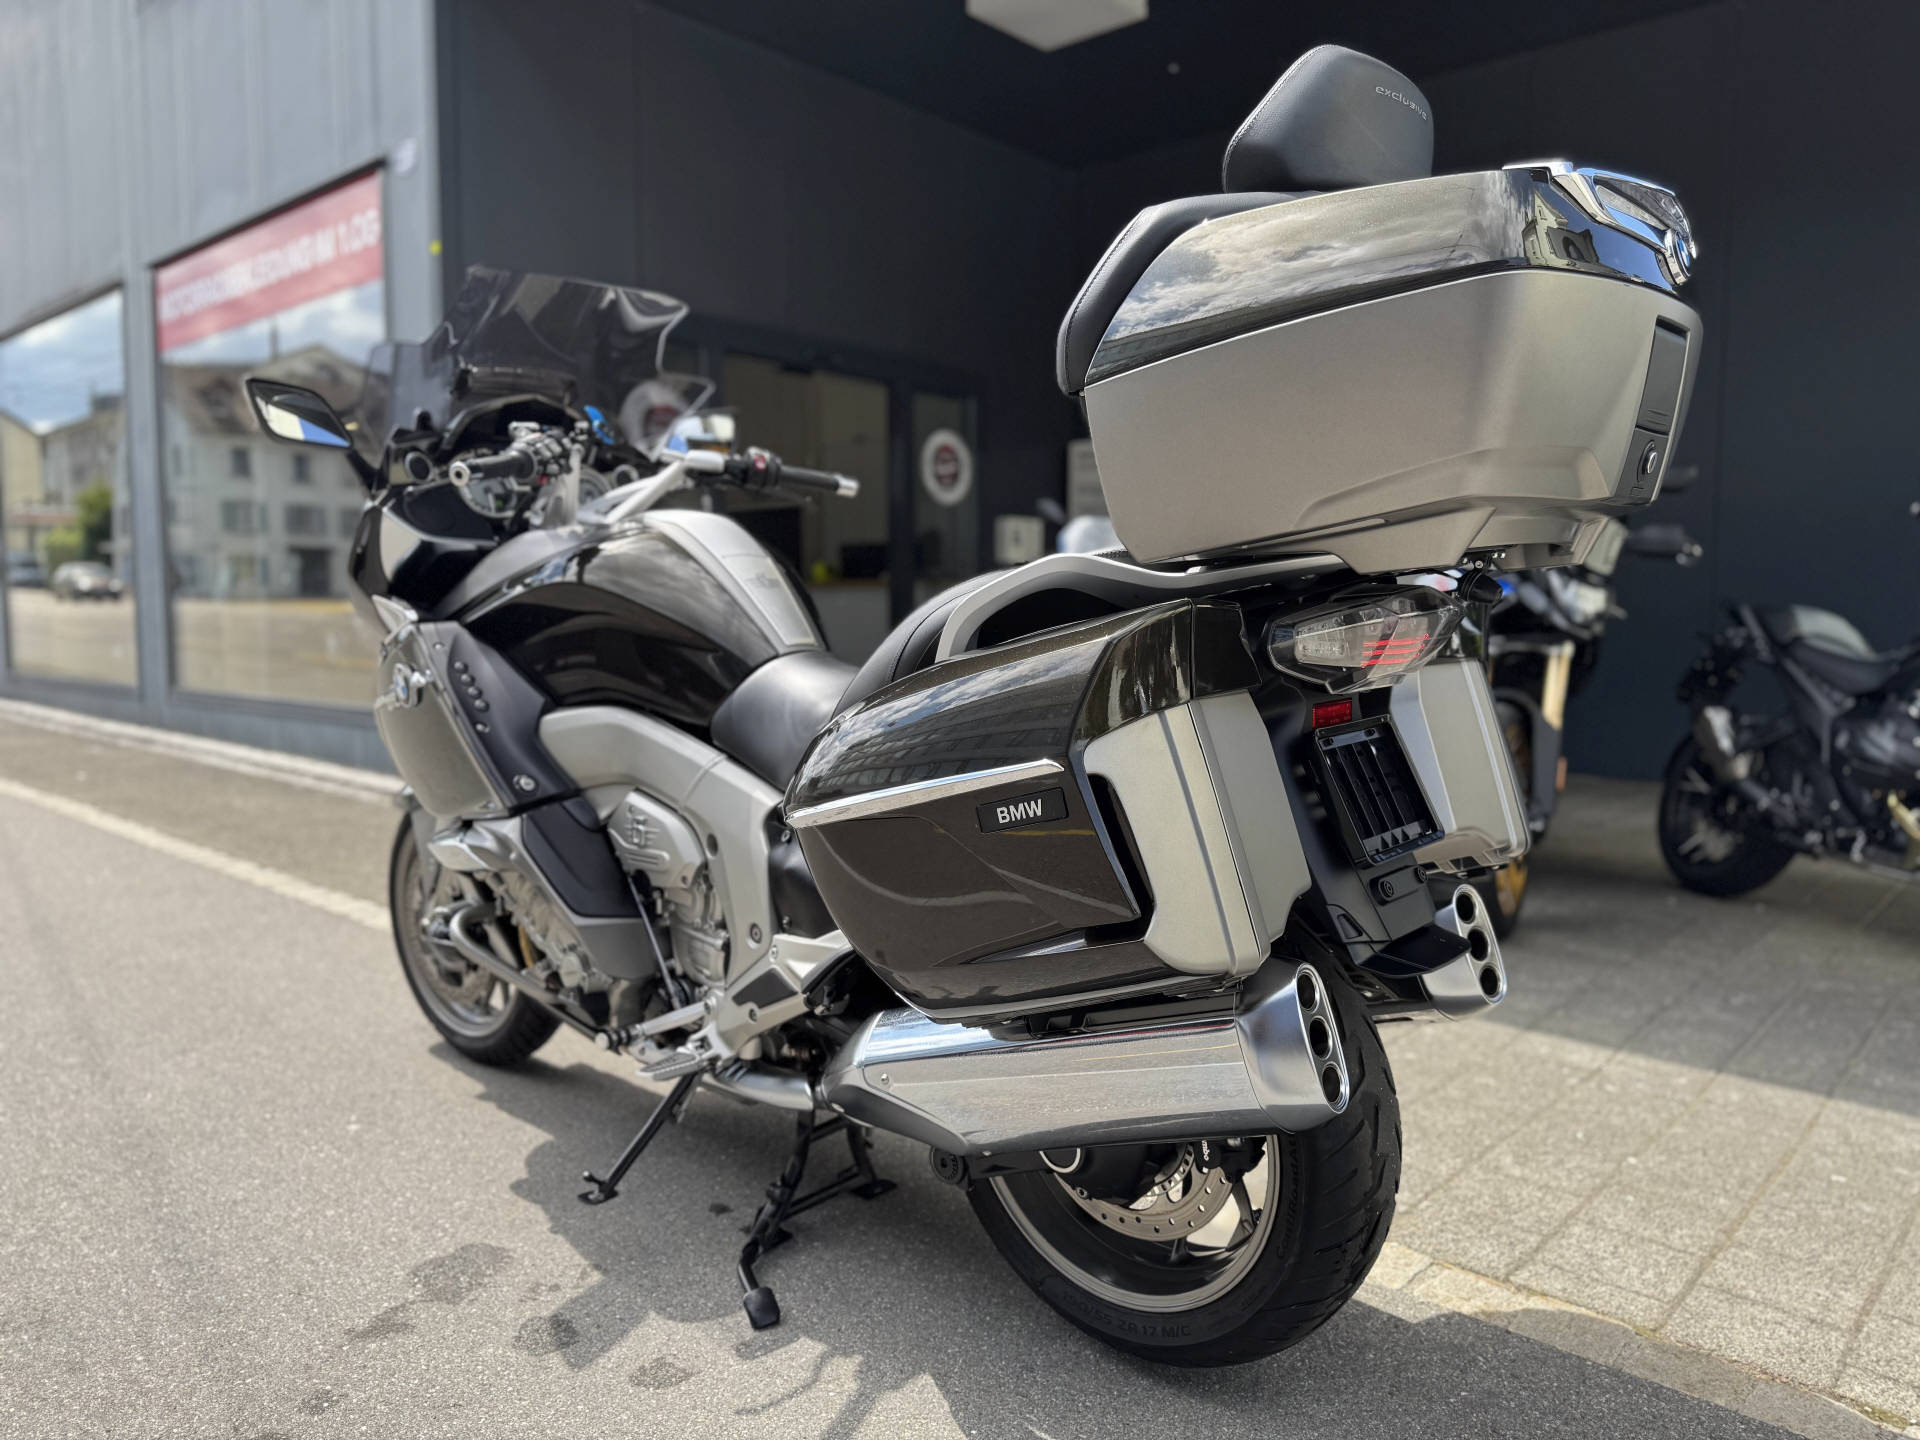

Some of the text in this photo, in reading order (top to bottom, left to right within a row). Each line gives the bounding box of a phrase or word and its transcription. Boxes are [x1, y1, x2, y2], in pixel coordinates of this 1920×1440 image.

[1375, 86, 1427, 121] exclusive
[997, 799, 1042, 824] BMW
[1141, 1324, 1157, 1338] 17
[1160, 1323, 1193, 1339] M/C
